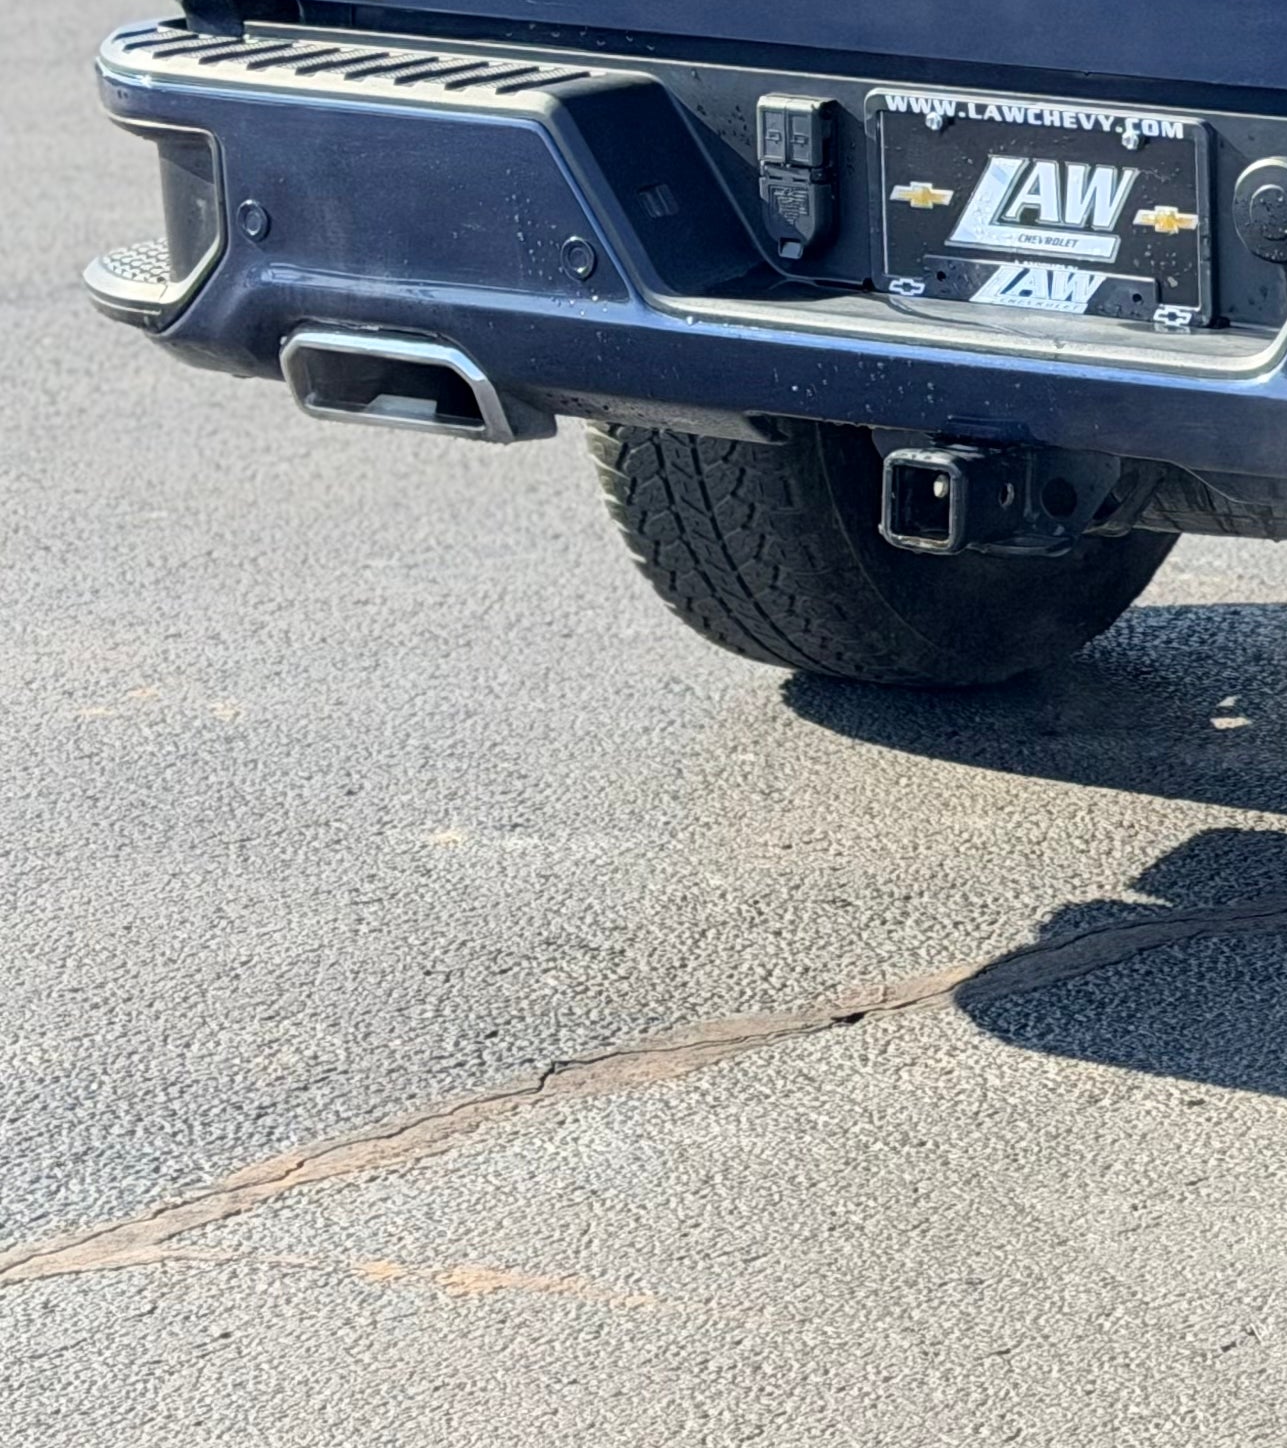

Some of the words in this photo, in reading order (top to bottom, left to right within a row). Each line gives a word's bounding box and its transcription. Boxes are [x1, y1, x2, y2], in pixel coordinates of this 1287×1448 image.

[886, 95, 1184, 139] WWW.LAWCHEVY.COM
[944, 154, 1140, 263] LAW
[1018, 233, 1079, 248] CHEVROLET
[969, 265, 1108, 314] LAW
